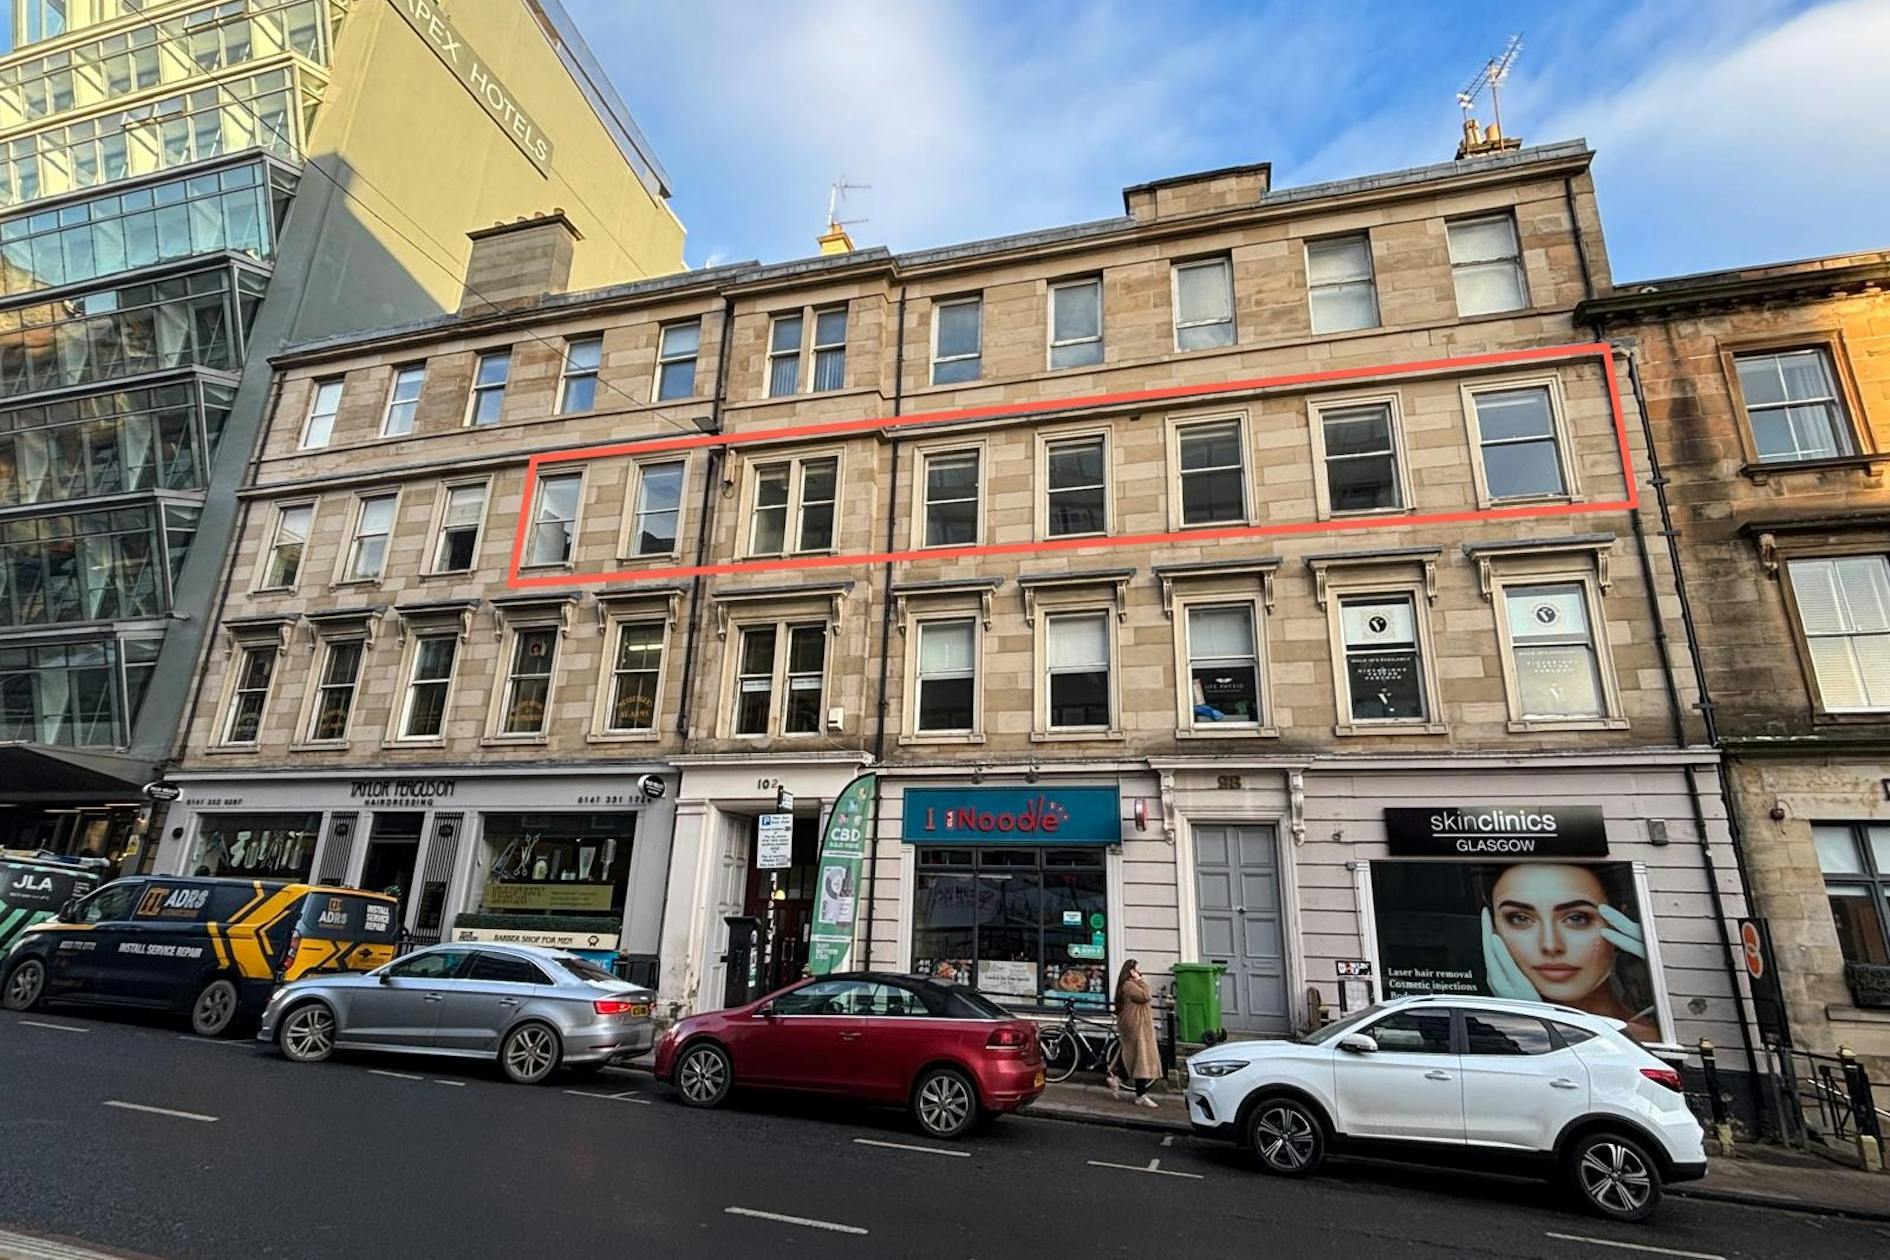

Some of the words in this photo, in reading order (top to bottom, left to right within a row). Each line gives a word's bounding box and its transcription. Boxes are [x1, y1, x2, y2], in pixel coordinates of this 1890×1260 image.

[470, 63, 547, 161] HOTELS
[351, 780, 390, 797] TAYLOR
[394, 780, 455, 797] FERGUSON
[757, 778, 778, 790] 102
[364, 798, 433, 806] HAIRDRESSING
[577, 795, 600, 804] 0141
[957, 795, 1058, 831] Noodle
[1430, 809, 1557, 831] skinclinics
[830, 827, 861, 842] CBD
[1456, 839, 1535, 852] GLASGOW
[12, 874, 52, 891] JLA
[163, 889, 209, 909] ADRS
[318, 910, 348, 925] ADRS
[494, 934, 520, 943] BARBER
[521, 935, 540, 944] SHOP
[541, 935, 556, 944] FOR
[557, 936, 573, 945] MEN
[118, 942, 146, 954] INSTALL
[146, 944, 177, 956] SERVICE
[176, 946, 203, 959] REPAIR
[1387, 967, 1414, 977] Laser
[1413, 968, 1434, 978] hair
[1435, 969, 1473, 979] removal
[1389, 978, 1431, 990] Cosmetic
[1432, 980, 1478, 991] injections
[1390, 991, 1411, 999] Bod
